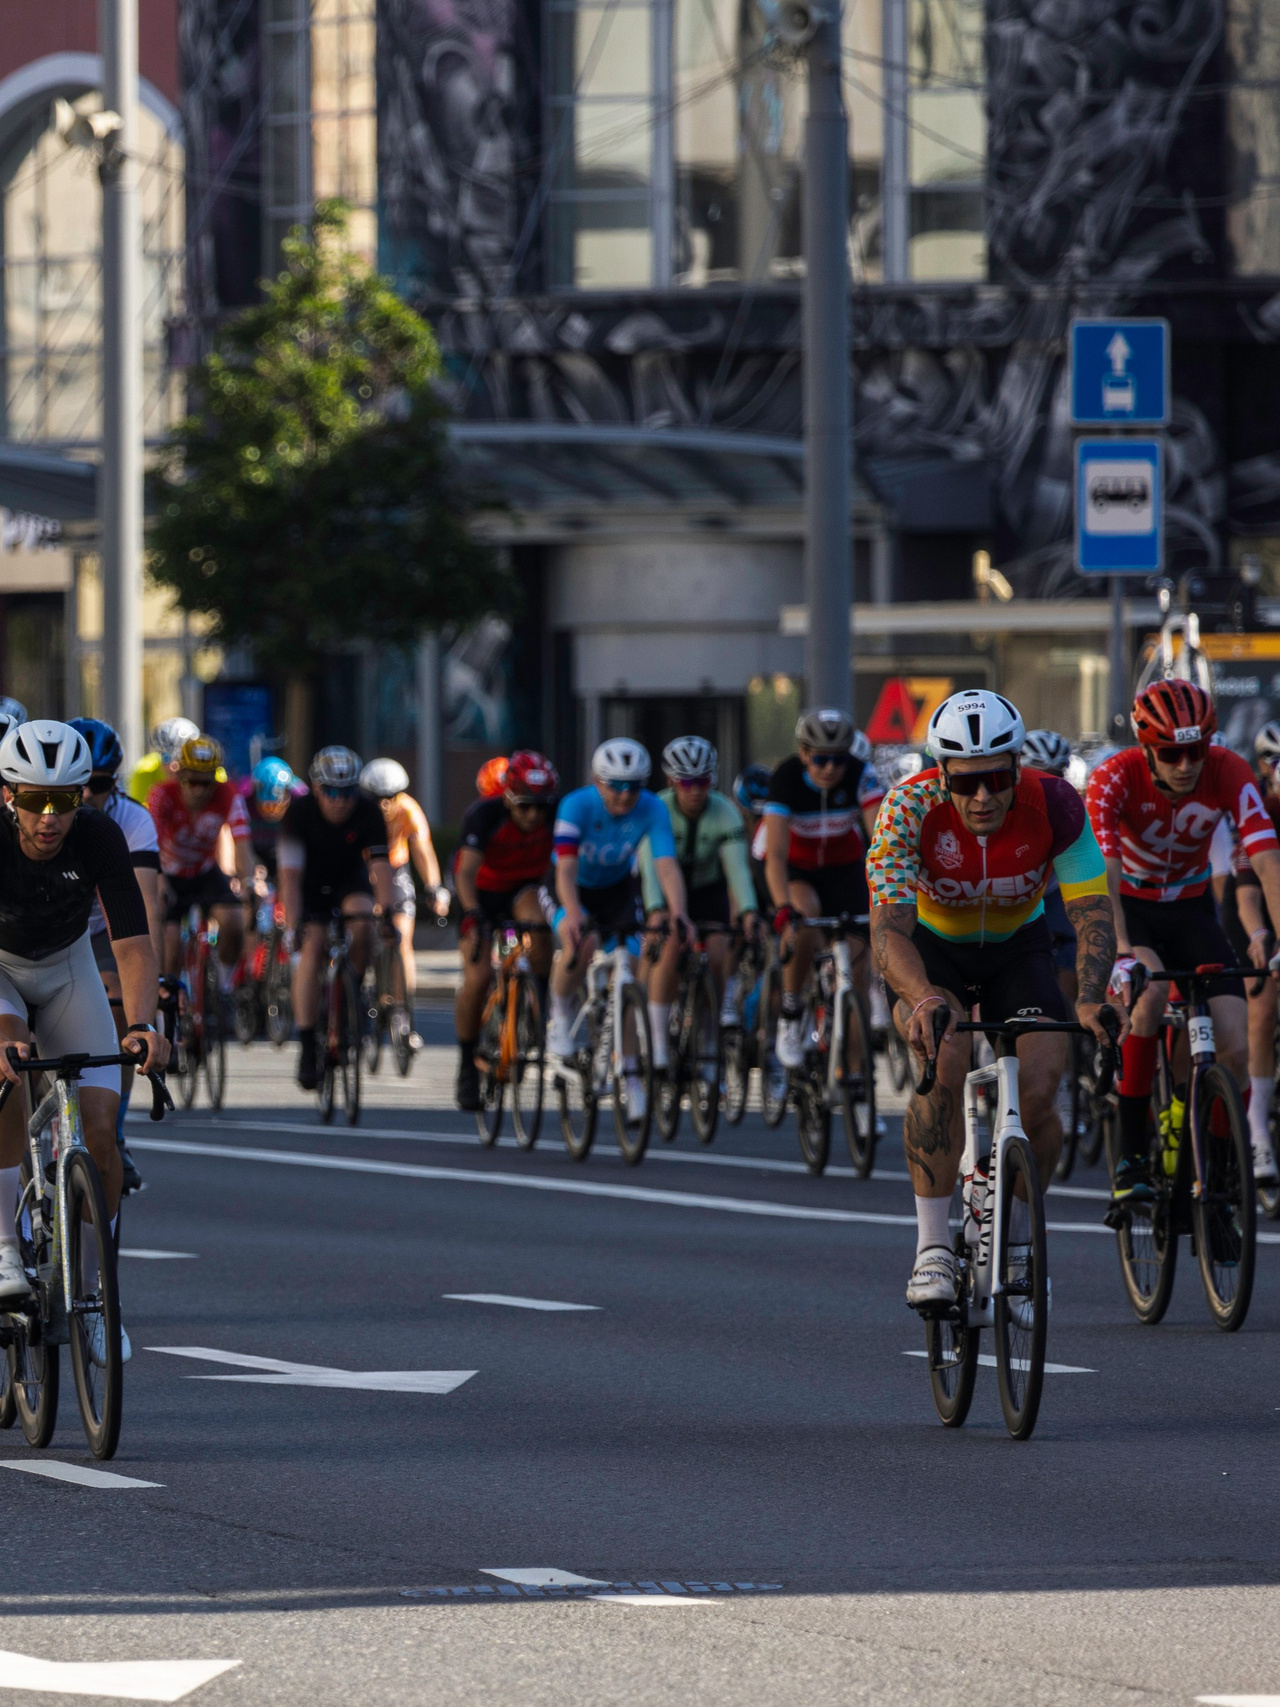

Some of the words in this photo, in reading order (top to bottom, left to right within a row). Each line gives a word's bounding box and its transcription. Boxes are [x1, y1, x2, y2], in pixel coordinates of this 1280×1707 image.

[958, 703, 986, 712] 5994
[1177, 729, 1200, 742] 953
[919, 862, 1047, 898] LOVELY
